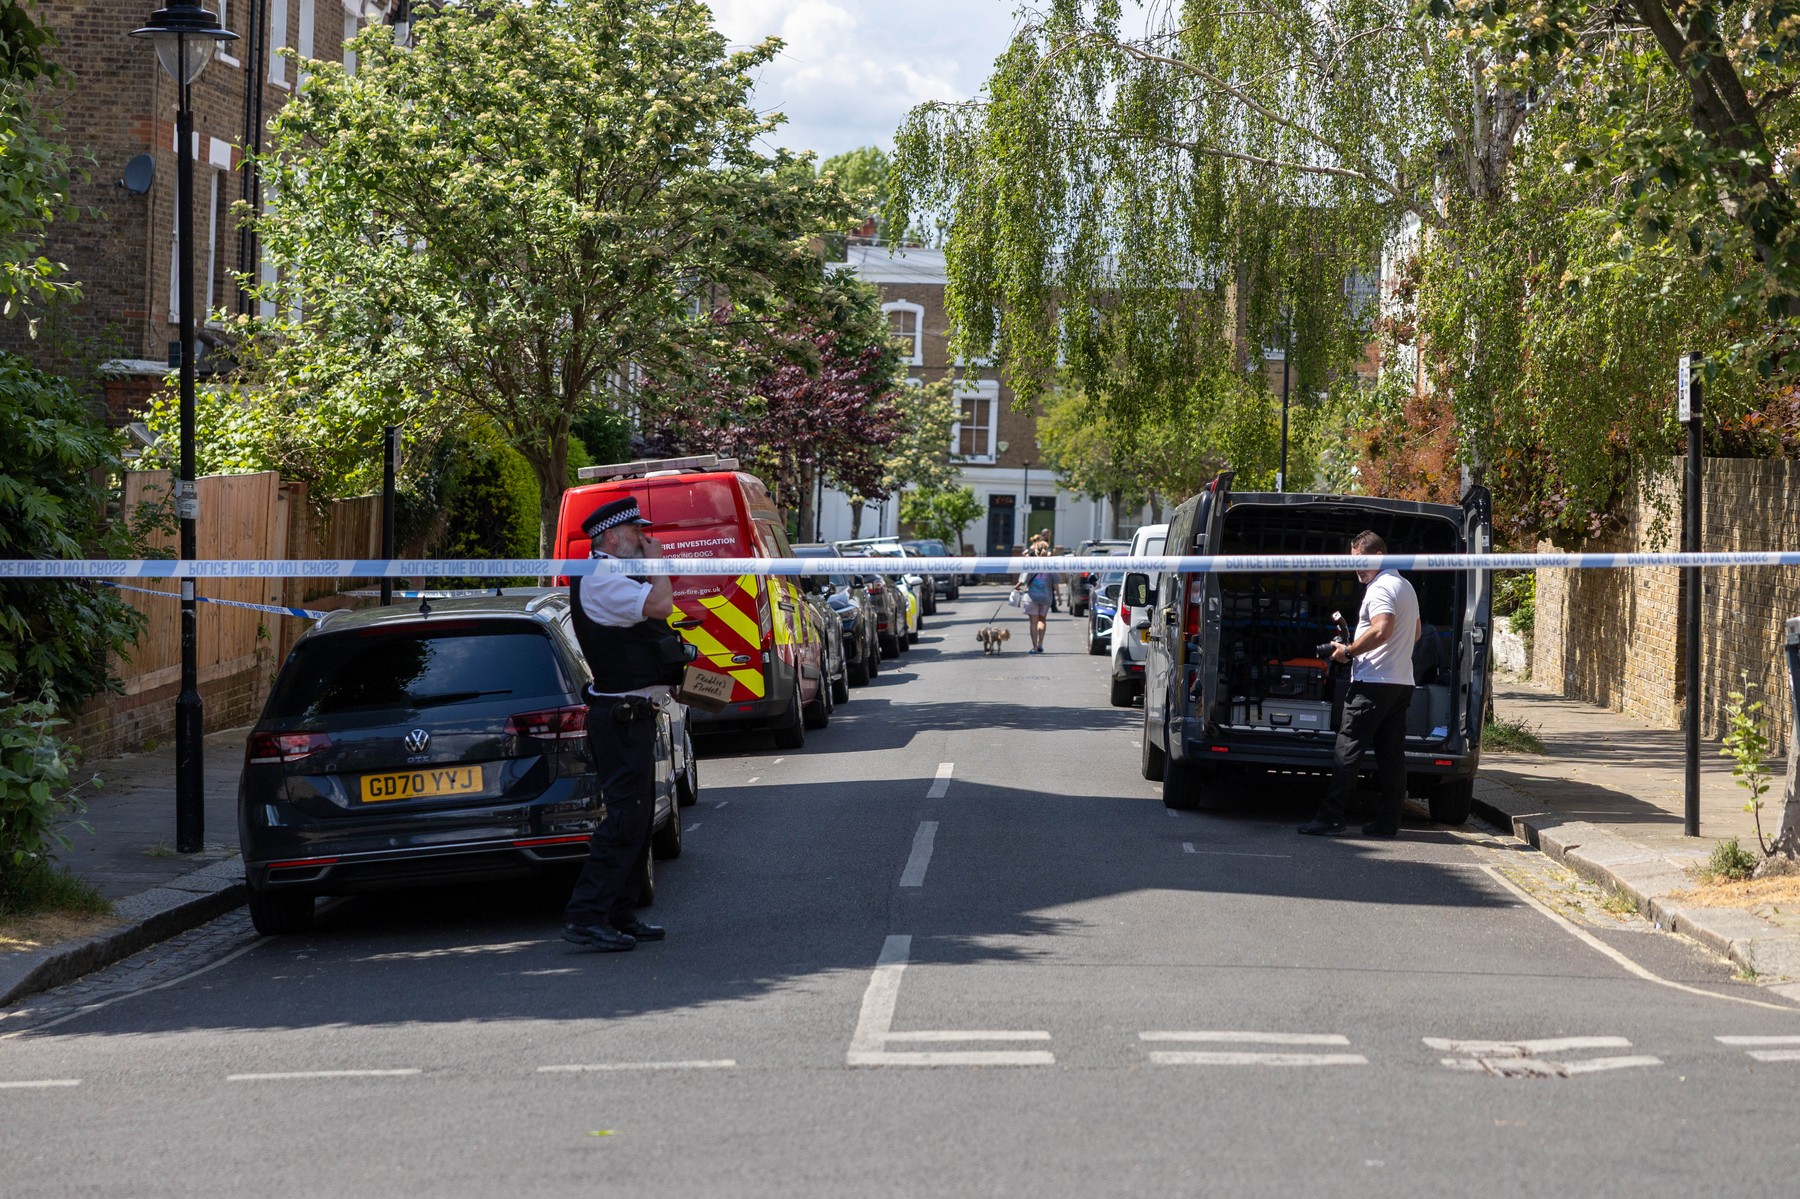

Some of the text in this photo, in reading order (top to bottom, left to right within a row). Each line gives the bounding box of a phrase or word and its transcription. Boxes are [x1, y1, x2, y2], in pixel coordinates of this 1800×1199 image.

[678, 538, 736, 548] INVESTIGATION
[673, 586, 721, 596] don-fire.gov.uk
[370, 769, 472, 796] GD70 YYJ
